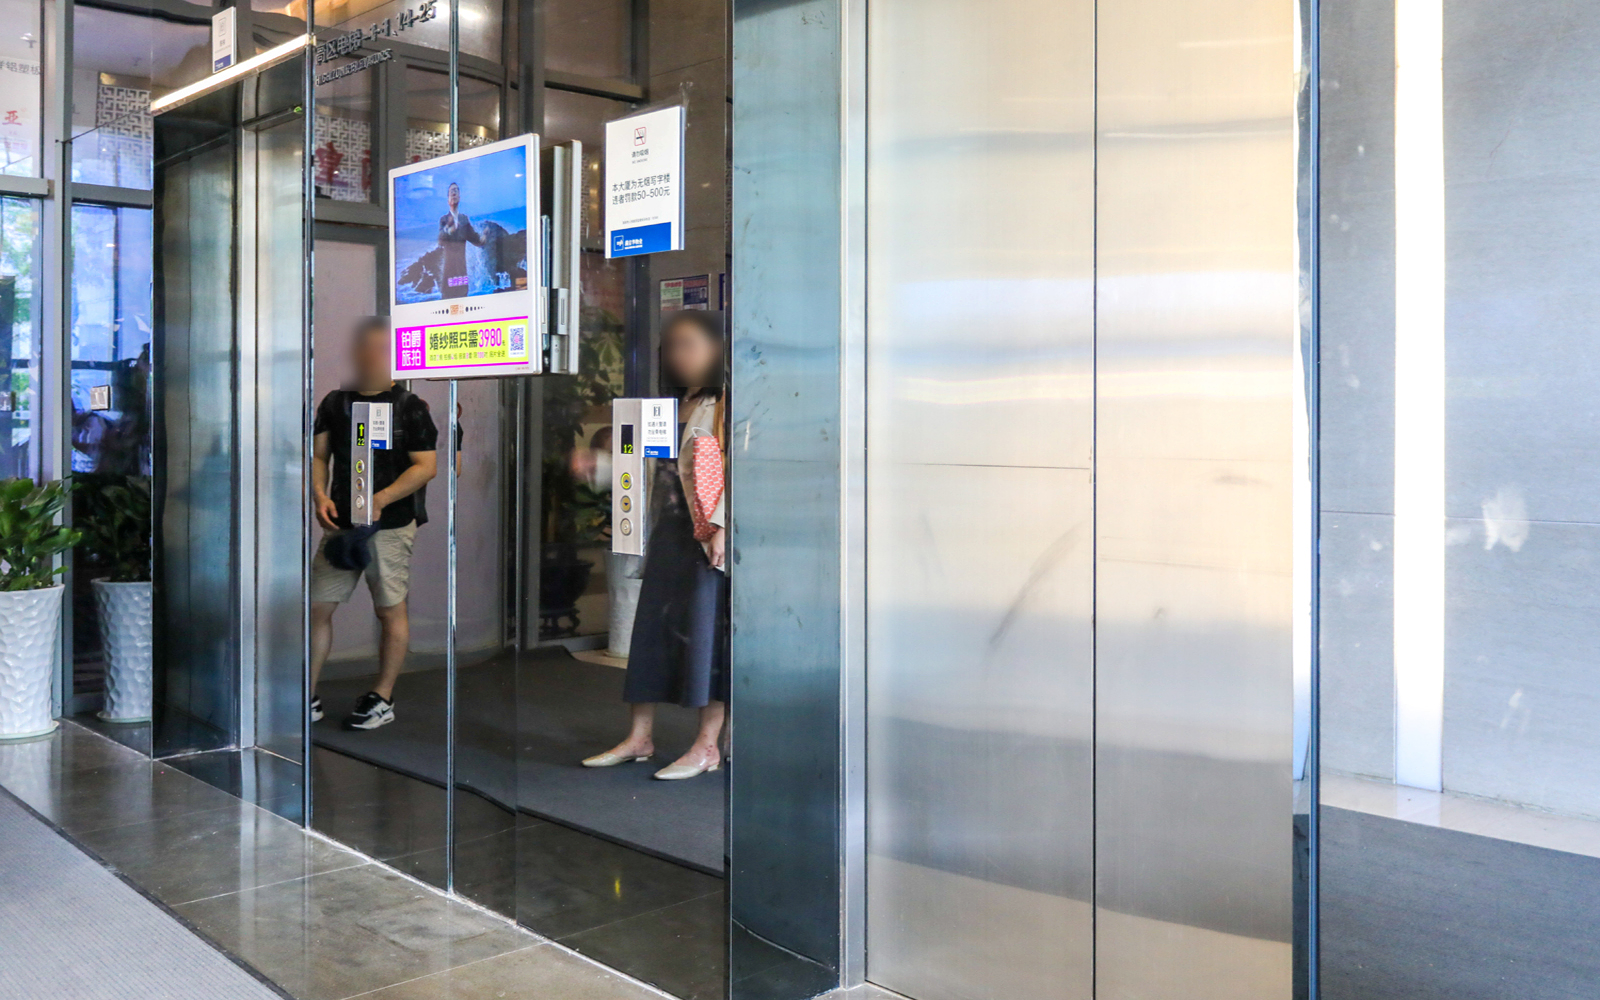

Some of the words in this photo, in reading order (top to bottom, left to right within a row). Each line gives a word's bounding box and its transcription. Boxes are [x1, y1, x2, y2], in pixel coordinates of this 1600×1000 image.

[612, 173, 670, 192] 本大厦为无烟写字楼
[401, 350, 421, 367] 旅拍
[623, 444, 633, 454] 12
